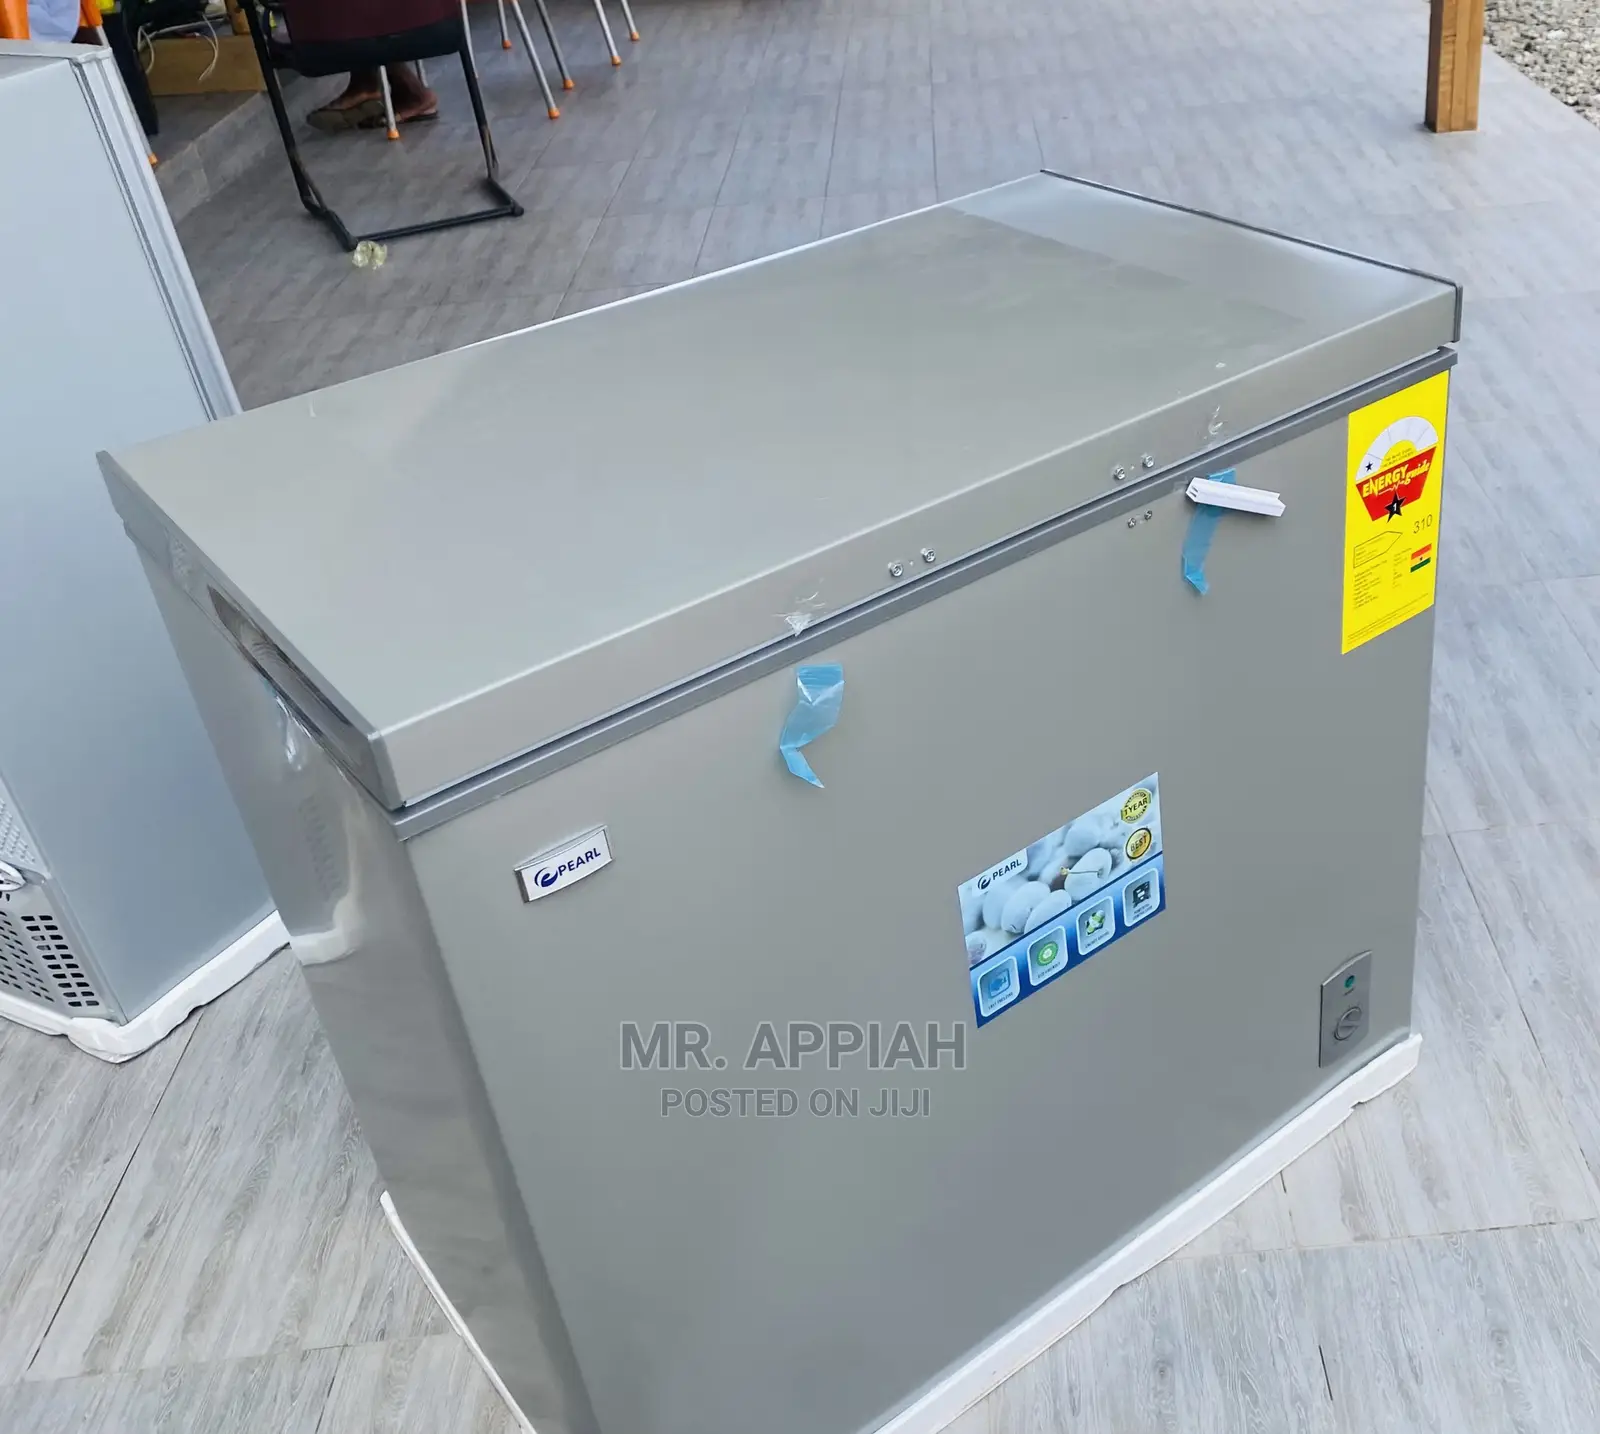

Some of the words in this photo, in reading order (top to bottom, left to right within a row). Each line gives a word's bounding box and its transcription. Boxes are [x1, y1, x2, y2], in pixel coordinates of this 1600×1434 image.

[1362, 464, 1409, 498] ENERGY
[1392, 502, 1397, 511] 1
[1413, 514, 1433, 534] 310
[1130, 834, 1148, 852] BEST
[557, 847, 602, 877] PEARL
[992, 858, 1022, 881] PEARL
